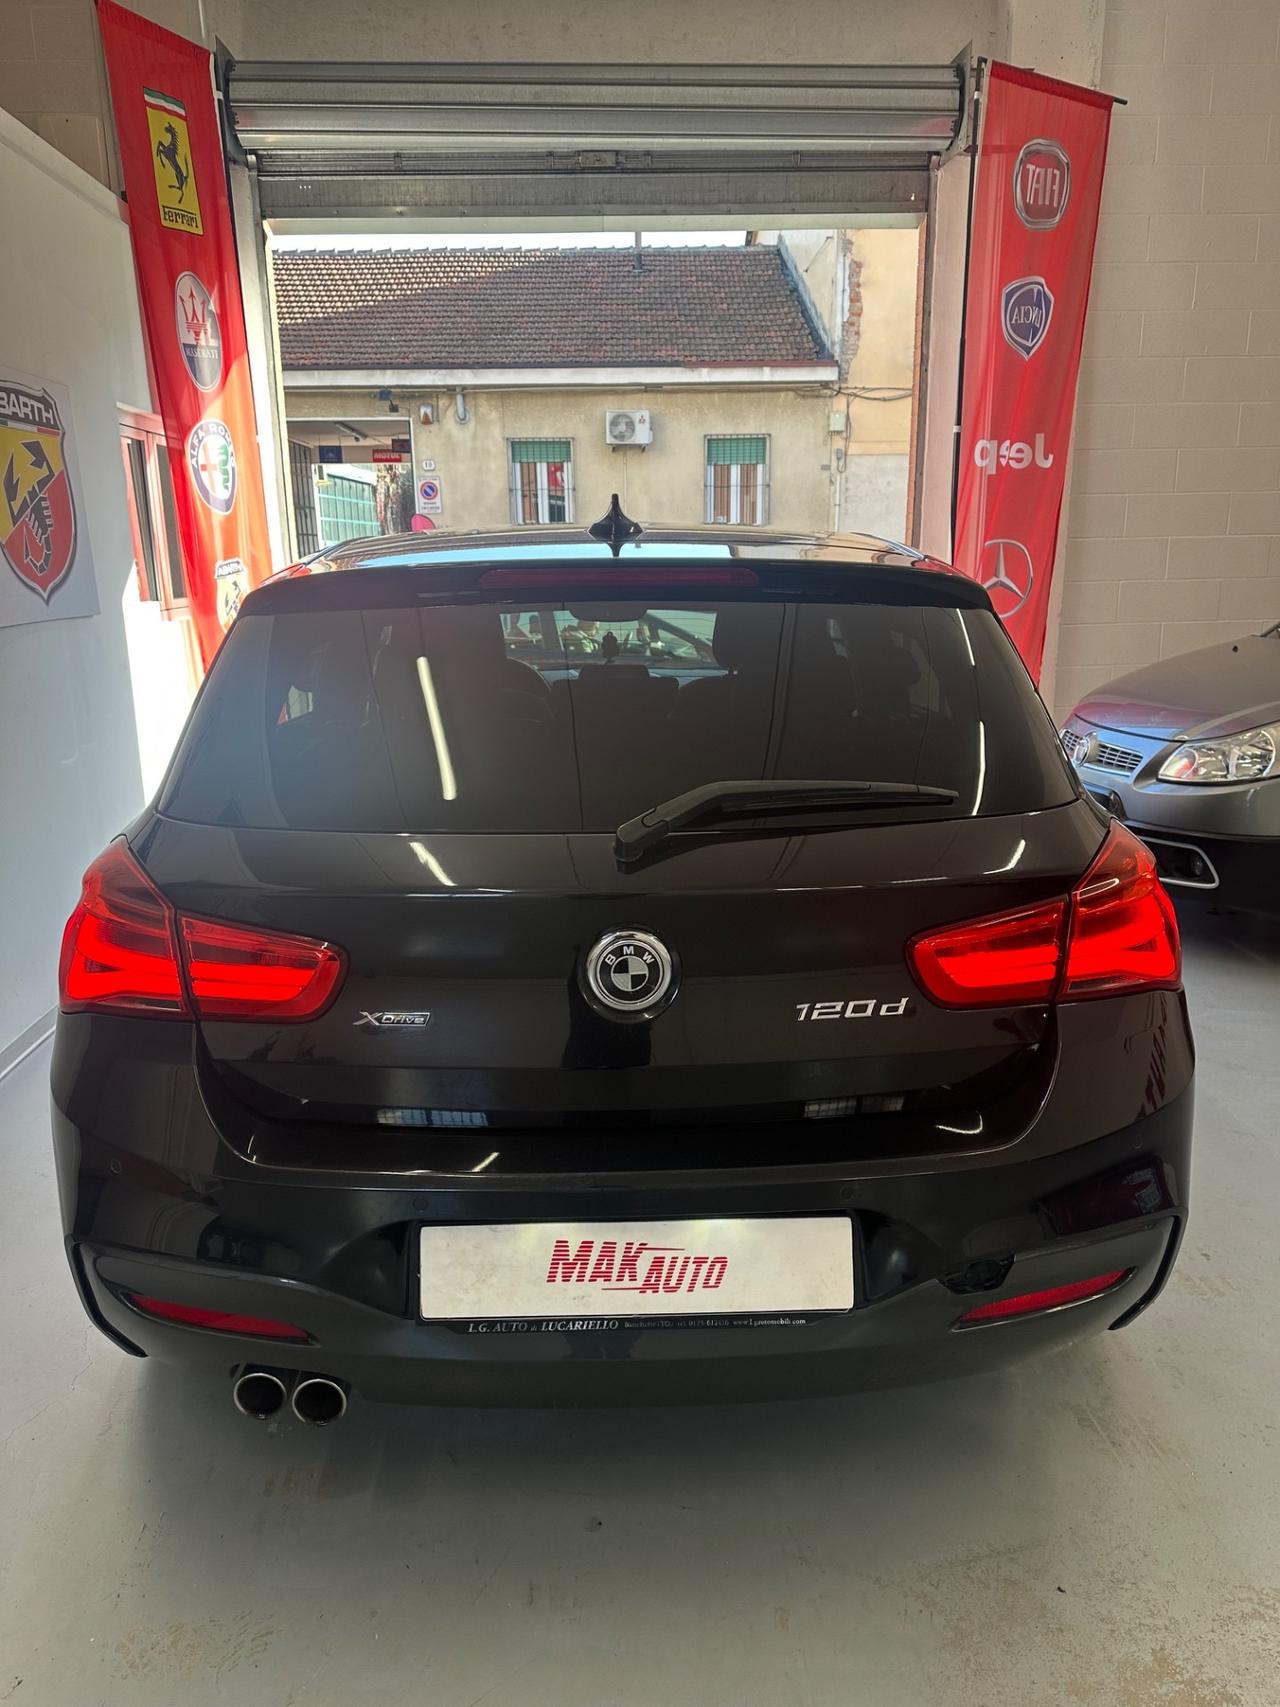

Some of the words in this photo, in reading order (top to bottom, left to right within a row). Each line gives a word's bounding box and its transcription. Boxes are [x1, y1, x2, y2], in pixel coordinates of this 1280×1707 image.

[162, 205, 199, 228] Ferrari
[185, 347, 219, 360] MASERATI
[190, 429, 206, 468] ALFA
[374, 452, 401, 460] MOTUL
[604, 945, 655, 966] BMW
[796, 997, 909, 1021] 120d
[546, 1239, 650, 1283] MAK
[638, 1256, 729, 1294] AUTO
[493, 1322, 528, 1333] AUTO
[541, 1319, 619, 1332] LUCARIELLO
